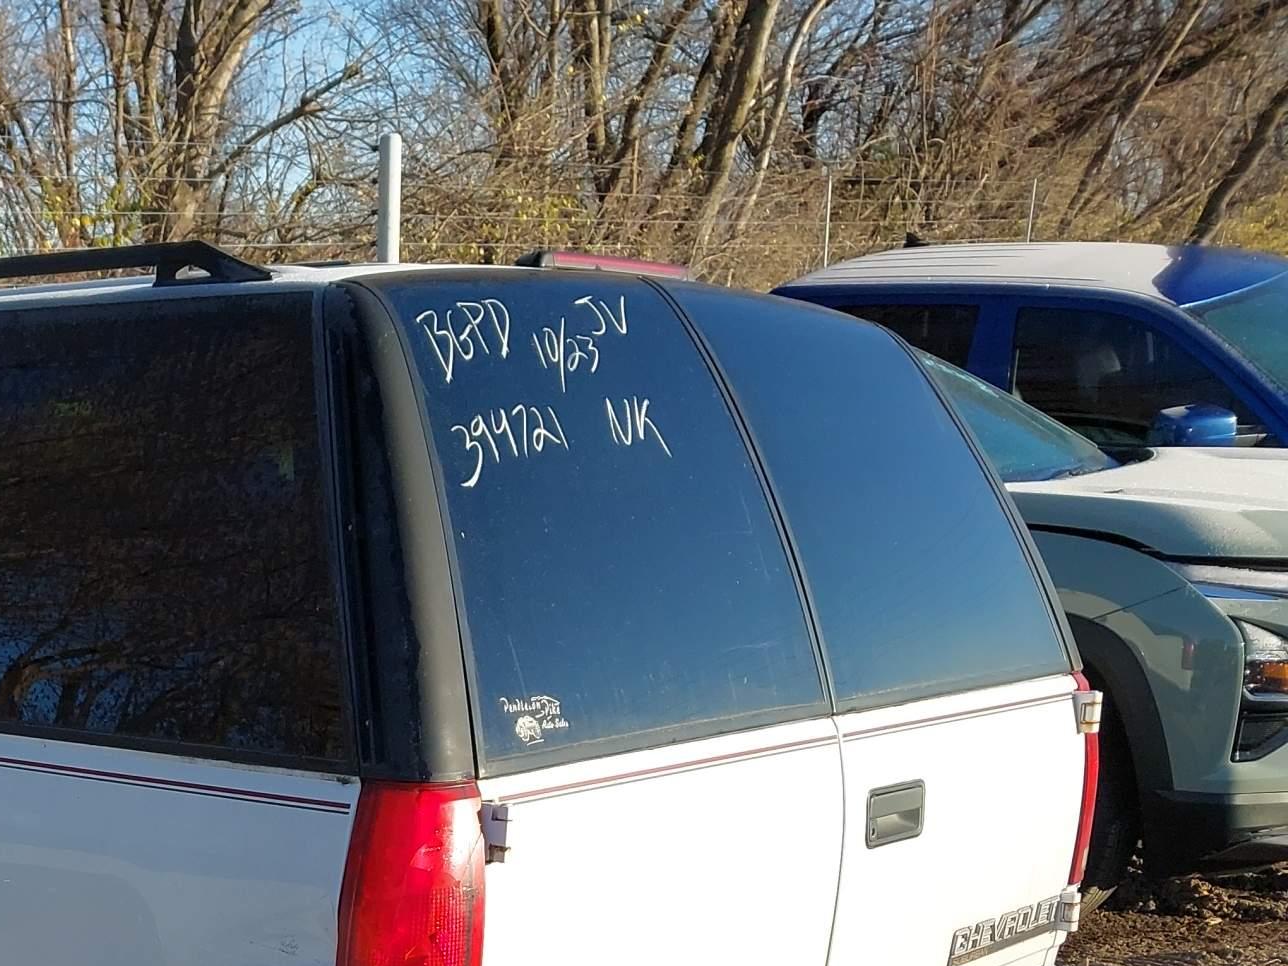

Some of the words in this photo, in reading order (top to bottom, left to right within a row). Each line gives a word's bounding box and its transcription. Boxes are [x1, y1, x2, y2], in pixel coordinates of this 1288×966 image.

[574, 295, 627, 336] JV
[532, 317, 600, 393] 10/23
[605, 395, 673, 458] NK
[951, 894, 1061, 956] CHEVROLET
